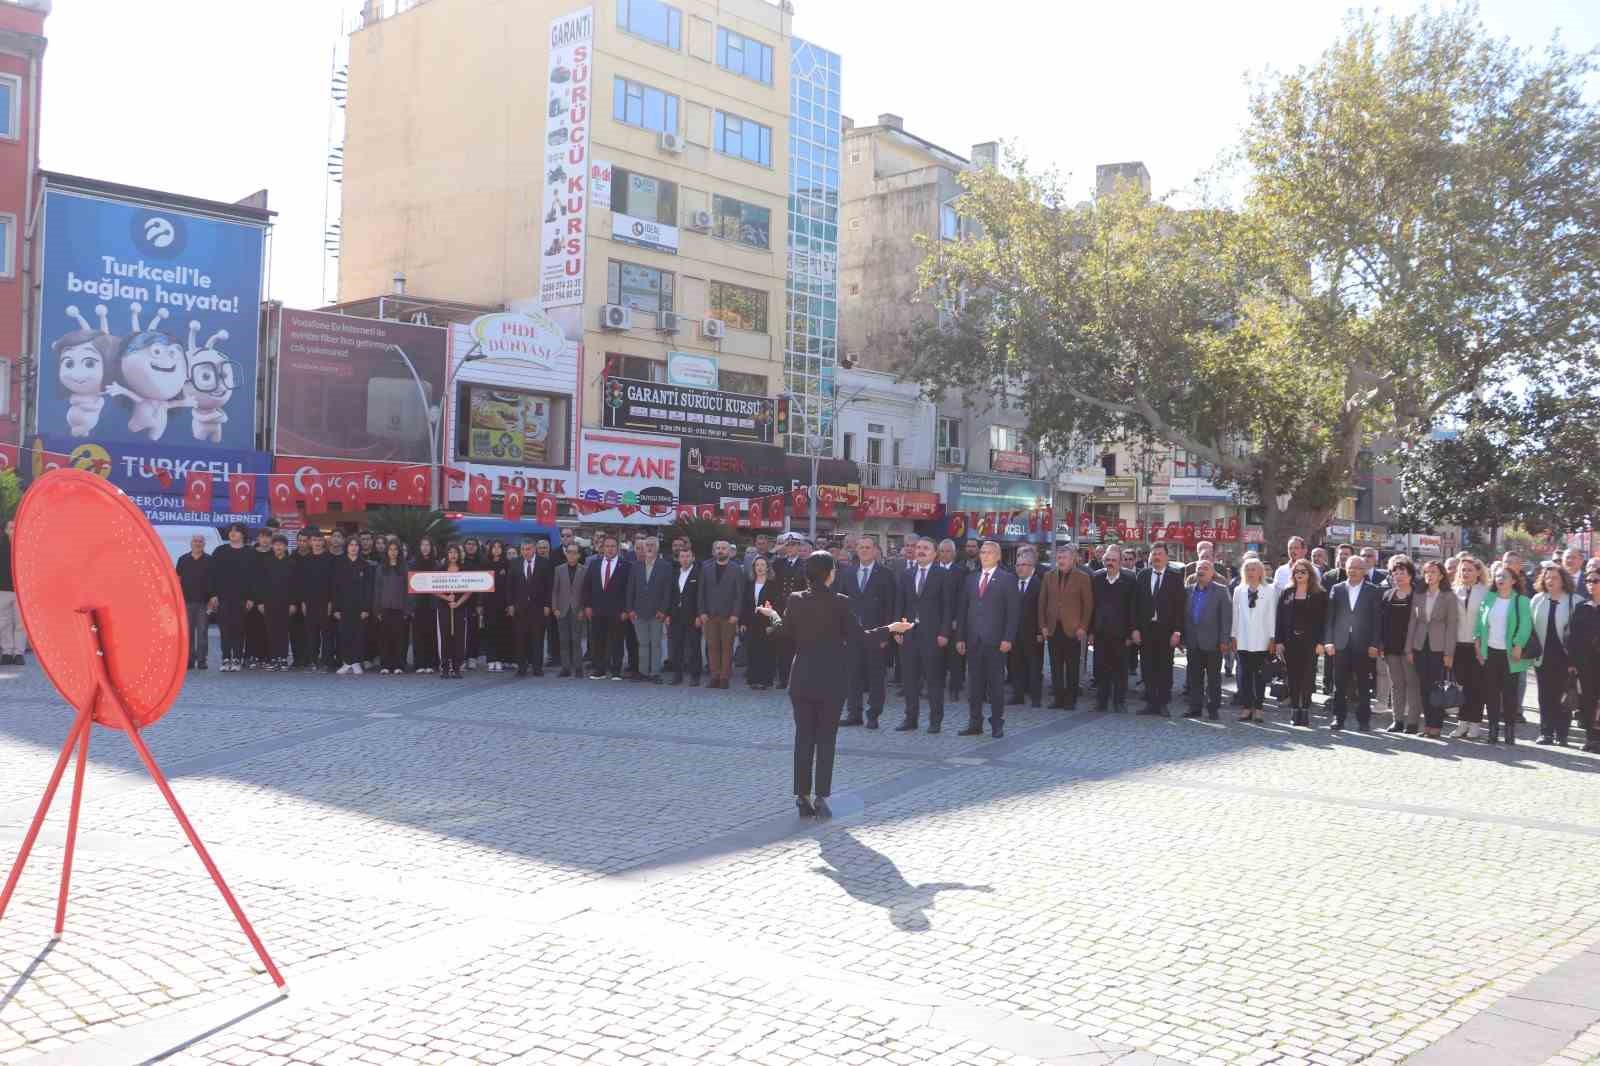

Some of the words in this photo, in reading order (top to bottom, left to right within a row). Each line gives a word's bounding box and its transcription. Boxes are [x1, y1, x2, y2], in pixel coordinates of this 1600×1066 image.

[565, 175, 584, 276] KURSU
[101, 255, 212, 289] Turkcell'le
[67, 272, 149, 301] bağlan
[155, 284, 239, 313] hayata!
[627, 385, 679, 406] GARANTİ
[680, 389, 723, 412] SÜRÜCÜ
[725, 397, 761, 416] KURSU
[497, 470, 567, 494] BÖREK
[587, 452, 674, 480] ECZANE
